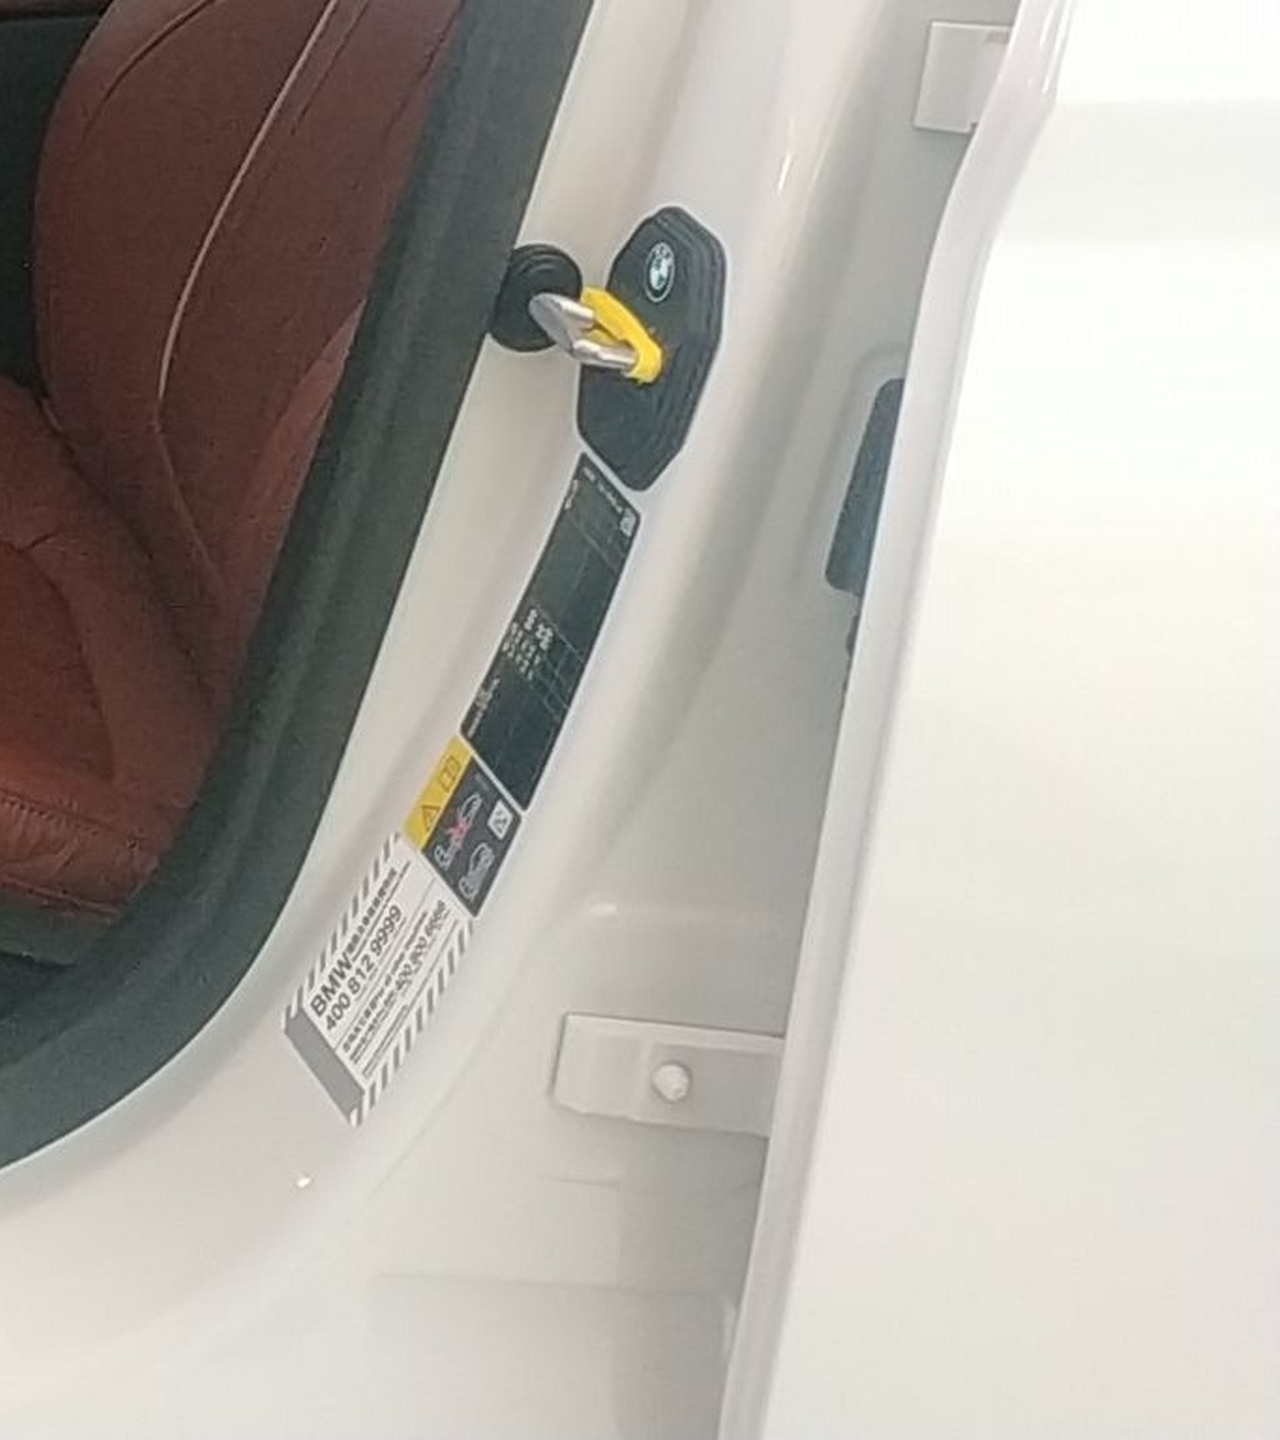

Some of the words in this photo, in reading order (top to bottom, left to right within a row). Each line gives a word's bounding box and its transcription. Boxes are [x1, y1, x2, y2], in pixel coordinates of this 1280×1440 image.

[310, 951, 352, 1017] BMW
[326, 992, 351, 1030] 400
[348, 954, 375, 994] 812
[370, 905, 401, 956] 9999
